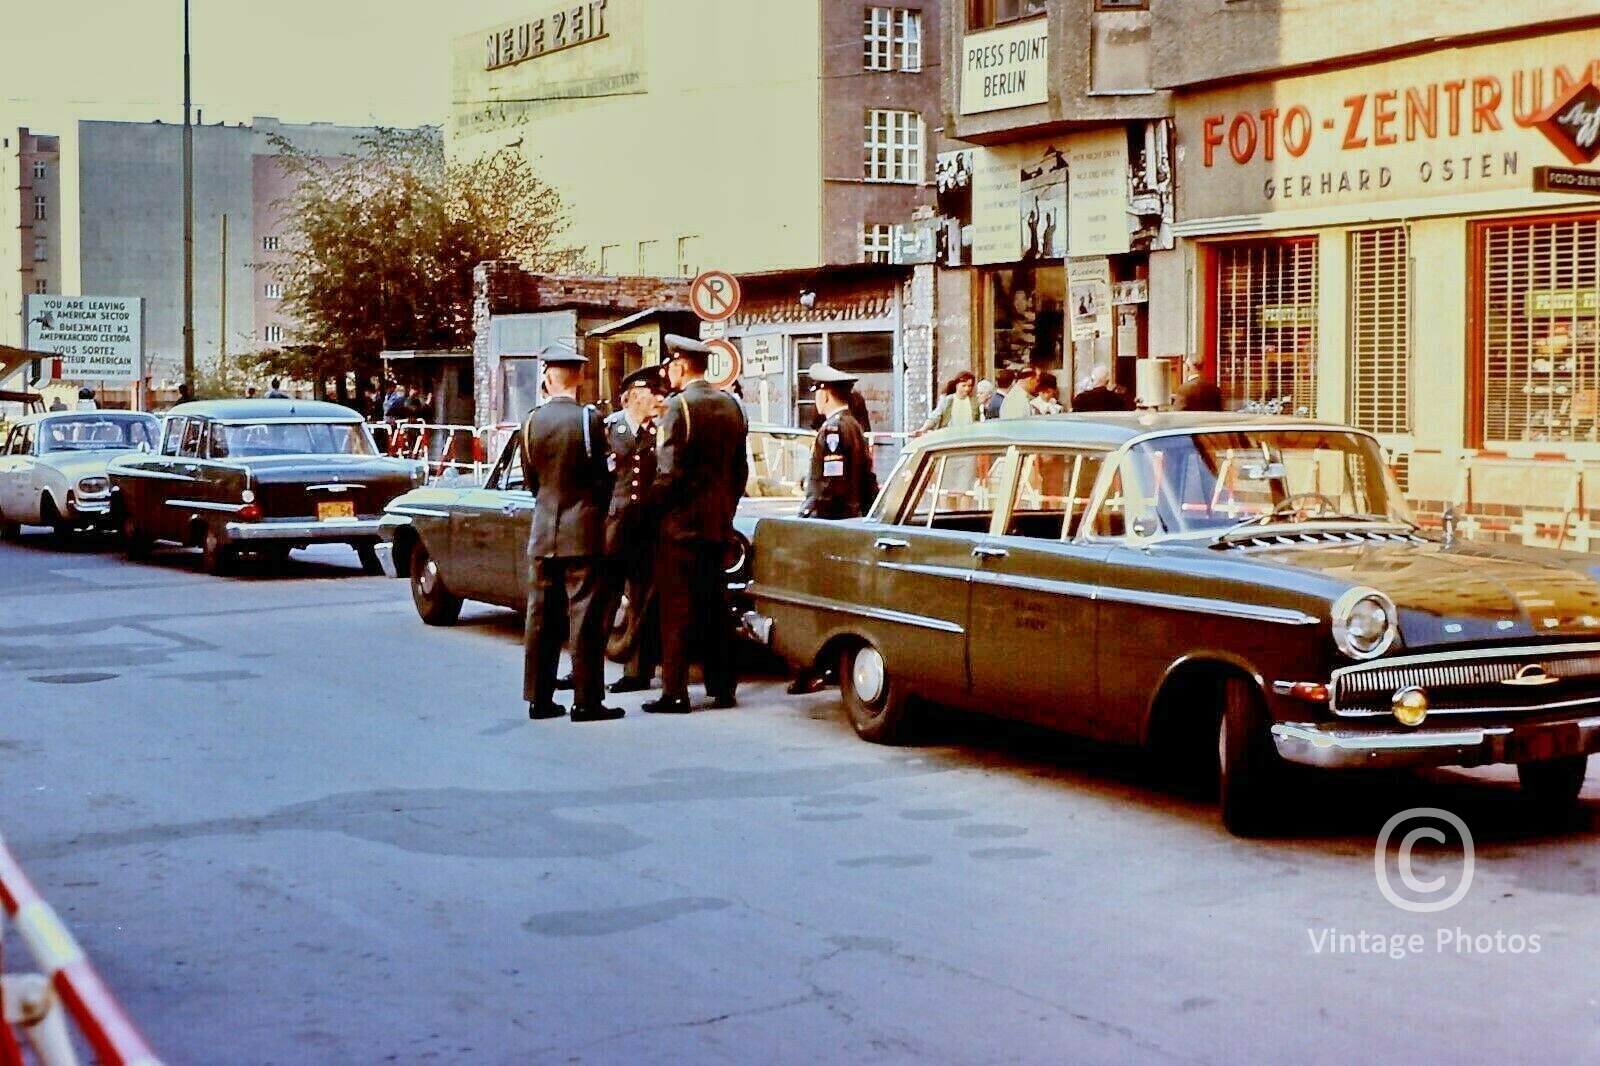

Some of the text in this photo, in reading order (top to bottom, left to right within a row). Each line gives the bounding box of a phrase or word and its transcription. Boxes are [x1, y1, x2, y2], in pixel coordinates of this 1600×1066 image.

[486, 0, 608, 67] NEUE ZEIT
[968, 36, 1048, 71] PRESS POINT
[984, 70, 1026, 98] BERLIN
[1264, 151, 1519, 200] GERHARD OSTEN
[710, 280, 724, 309] P
[44, 300, 126, 311] YOU ARE LEAVING
[57, 311, 97, 320] AMERICAN
[101, 312, 130, 320] SECTOR
[60, 323, 112, 333] ВЫЕЗЖАЕТЕ
[117, 324, 129, 333] ИЗ
[39, 332, 131, 343] АМЕРИКАНСКОГО СЕКТОРА
[53, 345, 115, 356] VOUS SORTEZ
[63, 356, 132, 366] CTEUR AMERICAIN
